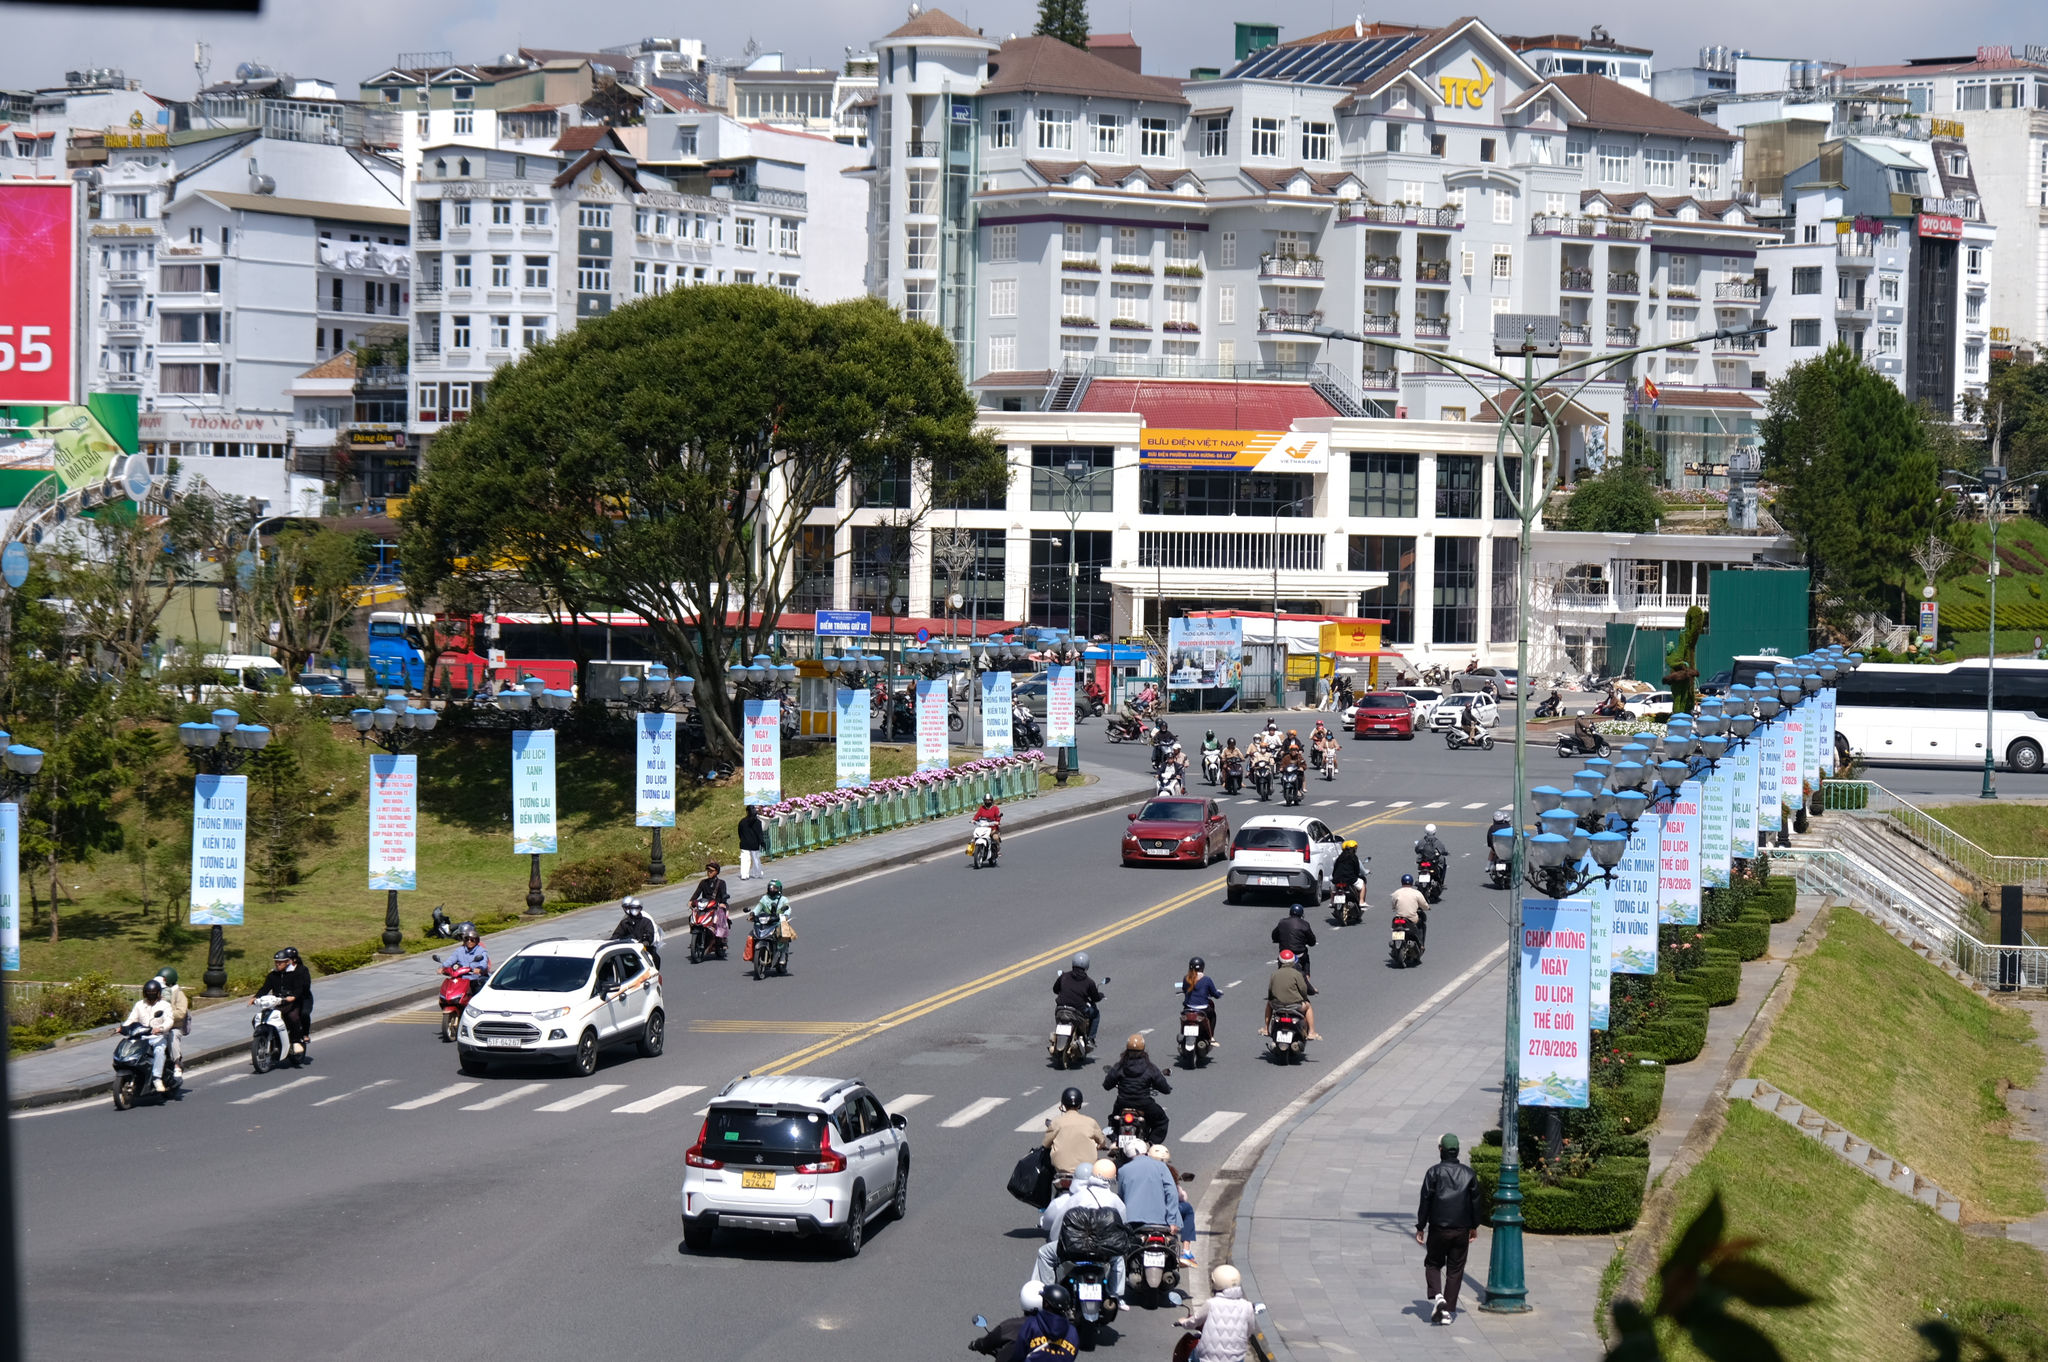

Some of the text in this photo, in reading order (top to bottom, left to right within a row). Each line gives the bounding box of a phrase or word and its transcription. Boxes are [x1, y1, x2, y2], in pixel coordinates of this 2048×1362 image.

[1439, 58, 1494, 108] TTC
[146, 133, 168, 147] HOTEL
[1923, 198, 1966, 217] KING MASSAGE
[1922, 217, 1939, 230] OYO
[1148, 437, 1170, 447] BƯU
[1171, 437, 1195, 448] ĐIỆN
[1196, 437, 1219, 448] VIỆT
[65, 450, 104, 482] MATCHA
[860, 622, 868, 631] XE
[998, 696, 1010, 704] MINH
[761, 714, 777, 725] MỪNG
[1786, 722, 1802, 732] MỪNG
[641, 727, 673, 742] CÔNG NGHỆ
[755, 729, 769, 739] NGÀY
[653, 743, 661, 755] SỐ
[752, 744, 772, 755] DU LỊCH
[1762, 739, 1775, 749] LỊCH
[522, 749, 546, 764] DU LỊCH
[1766, 753, 1781, 761] MINH
[1785, 749, 1797, 759] LỊCH
[647, 758, 666, 770] MỞ LỐI
[751, 756, 761, 766] THẾ
[1737, 756, 1750, 767] LỊCH
[526, 765, 543, 776] XANH
[749, 771, 775, 781] 27/9/2026
[1765, 767, 1776, 778] TẠO
[645, 774, 667, 787] DU LỊCH
[1768, 781, 1777, 790] LAI
[642, 788, 671, 799] TƯƠNG LAI
[1762, 793, 1776, 805] VỮNG
[207, 798, 235, 813] DU LỊCH
[519, 797, 551, 808] TƯƠNG LAI
[1655, 800, 1697, 815] CHÀO MỪNG
[1742, 803, 1751, 813] LAI
[197, 814, 243, 830] THÔNG MINH
[519, 810, 551, 824] BỀN VỮNG
[1735, 816, 1750, 829] VỮNG
[1666, 818, 1685, 833] NGÀY
[202, 834, 236, 853] KIẾN TẠO
[1629, 838, 1646, 854] LỊCH
[1662, 840, 1689, 855] DU LỊCH
[199, 856, 237, 869] TƯƠNG LAI
[1634, 859, 1655, 873] MINH
[1661, 856, 1689, 871] THẾ GIỚI
[199, 873, 237, 889] BỀN VỮNG
[1659, 878, 1692, 890] 27/9/2026
[1633, 880, 1648, 896] TẠO
[1614, 899, 1649, 914] ƯƠNG LAI
[1628, 918, 1648, 935] VỮNG
[1525, 927, 1586, 949] CHÀO MỪNG
[1541, 955, 1568, 976] NGÀY
[1594, 969, 1608, 977] CAO
[1535, 985, 1573, 1006] DU LỊCH
[1533, 1008, 1574, 1030] THẾ GIỚI
[1529, 1038, 1578, 1058] 27/9/2026
[752, 1171, 767, 1179] 49A
